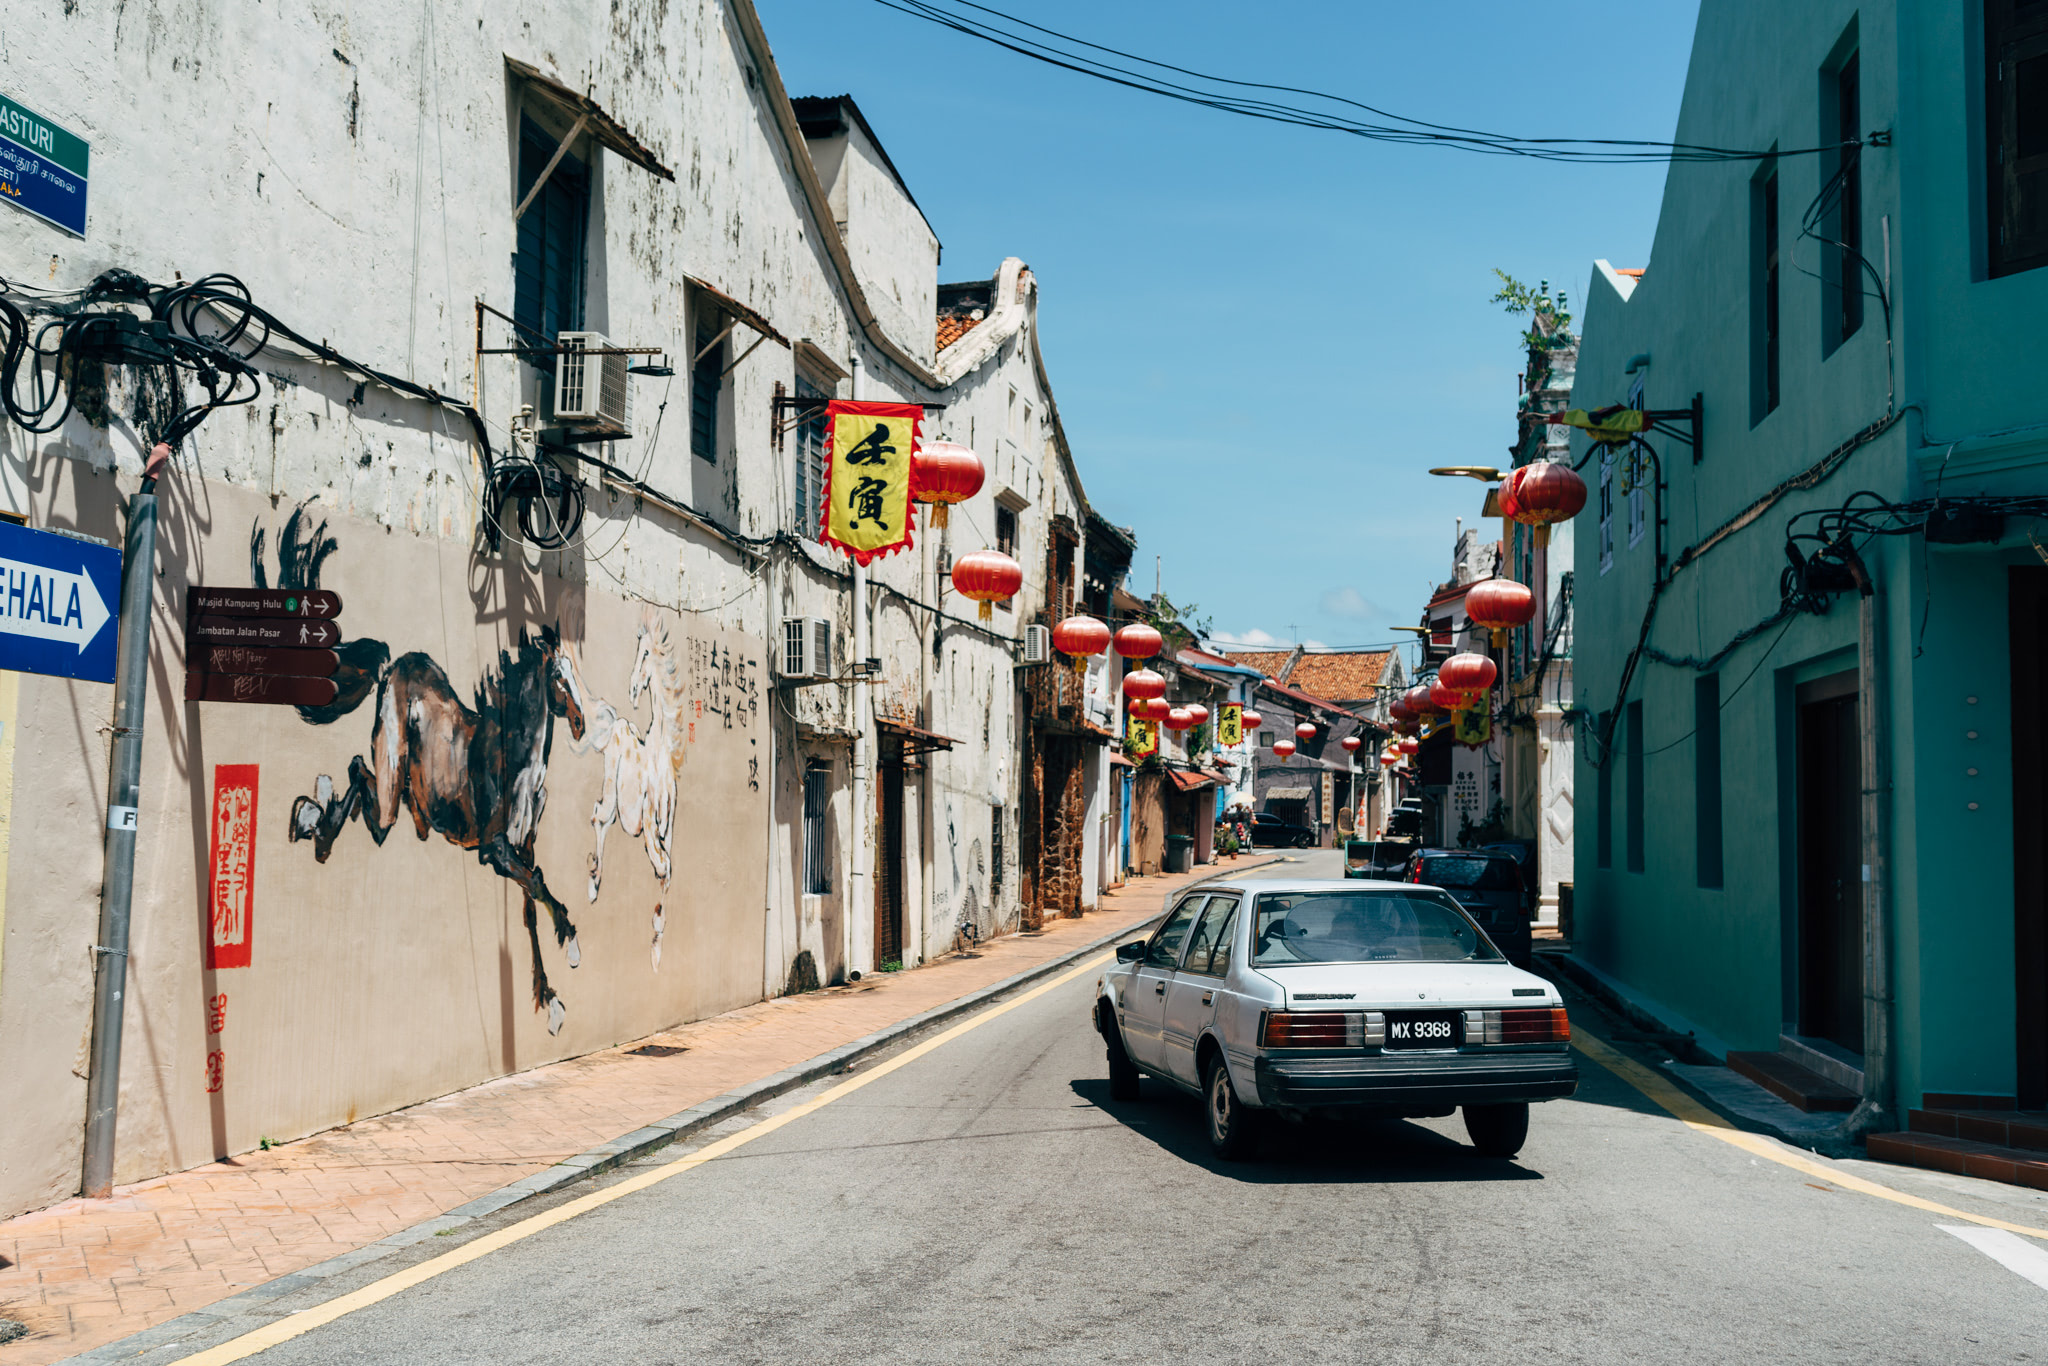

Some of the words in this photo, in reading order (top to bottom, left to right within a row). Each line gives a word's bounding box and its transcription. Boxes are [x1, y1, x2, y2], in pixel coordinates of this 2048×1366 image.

[845, 423, 896, 531] 壬寅
[198, 597, 223, 609] Masjid
[224, 598, 260, 610] Kampung
[263, 599, 282, 609] Hulu
[197, 625, 235, 636] Jambatan
[237, 627, 257, 637] Jalan
[259, 628, 281, 638] Pasar
[710, 640, 722, 714] 大道
[1223, 708, 1238, 740] 壬寅
[1391, 1022, 1411, 1039] MX
[1414, 1021, 1451, 1038] 9368
